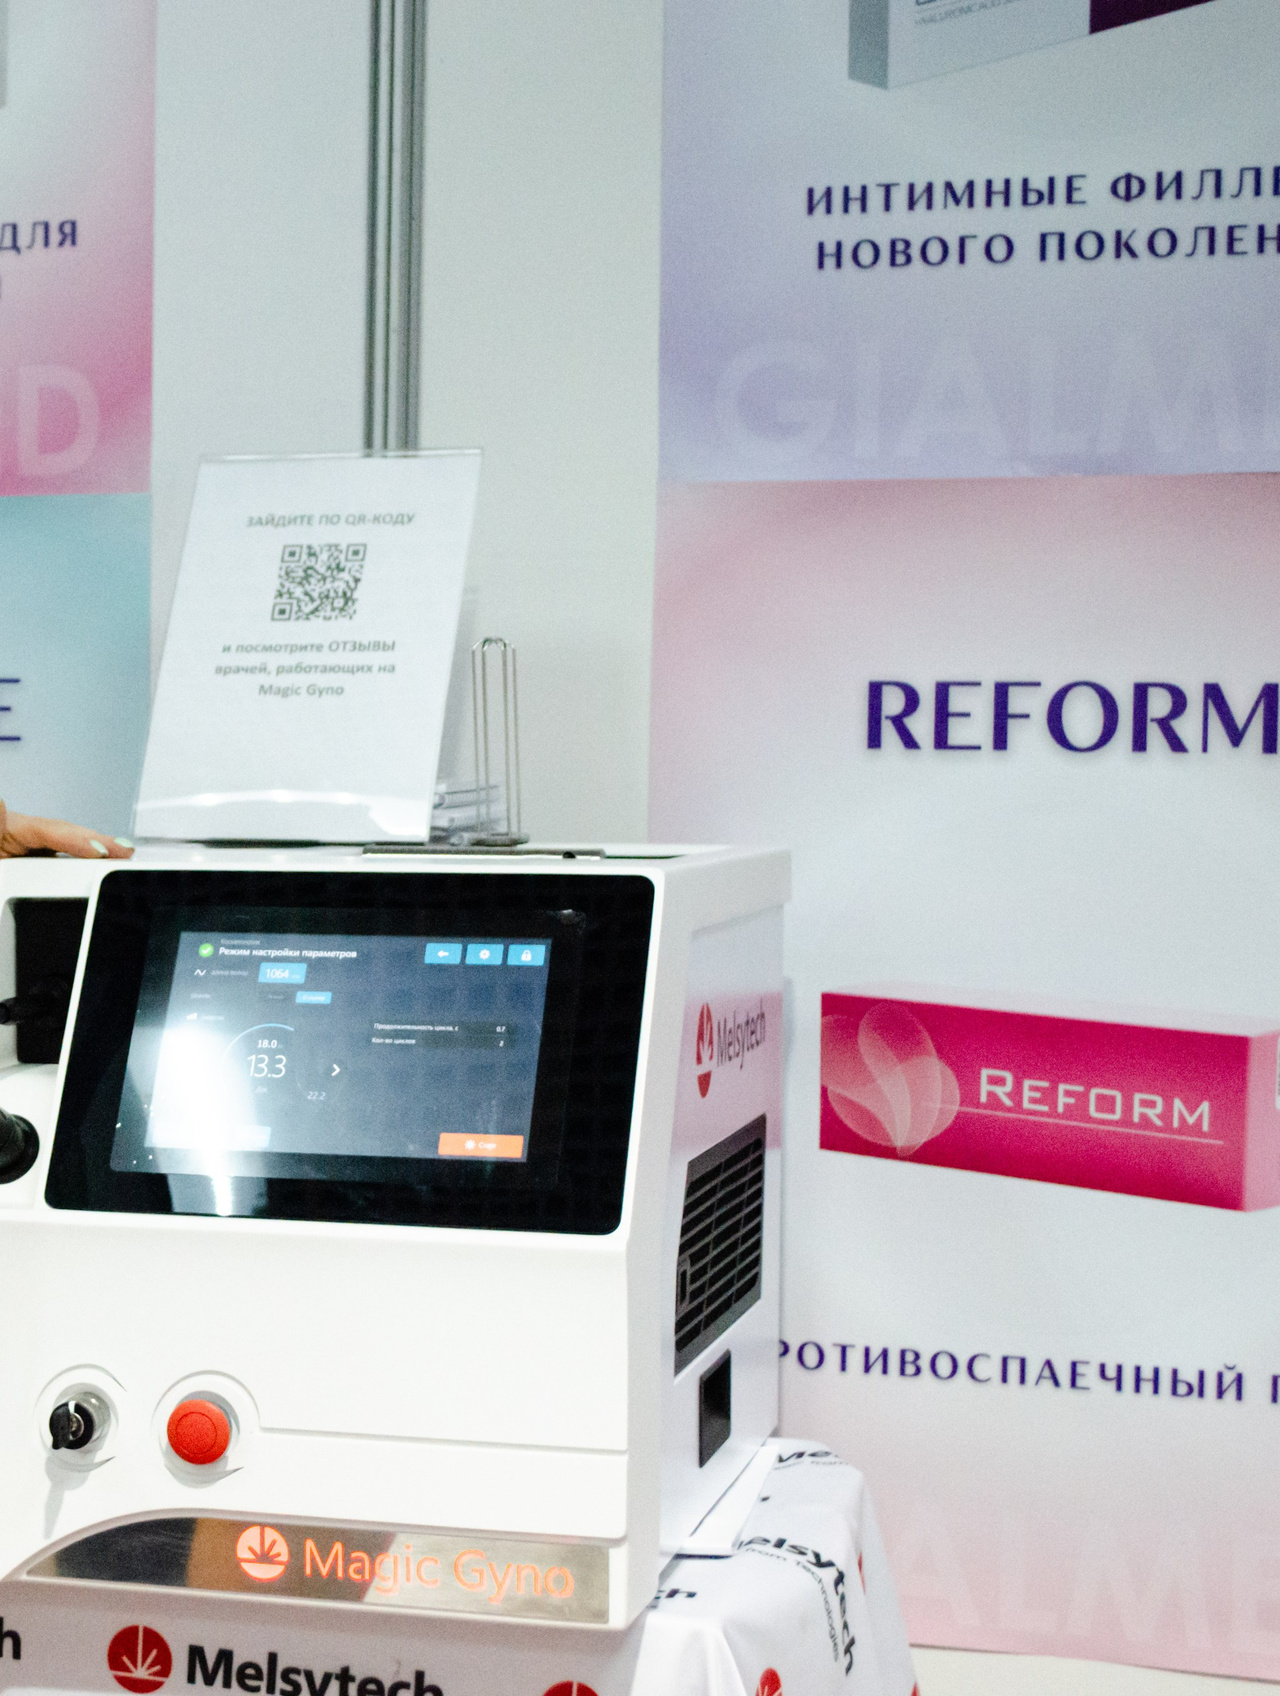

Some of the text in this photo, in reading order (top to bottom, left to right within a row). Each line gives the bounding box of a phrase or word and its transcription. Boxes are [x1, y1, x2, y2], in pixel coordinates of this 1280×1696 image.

[806, 174, 1088, 217] ИНТИМНЫЕ
[817, 223, 1280, 271] НОВОГО ПОКОЛЕН
[246, 512, 416, 529] ЗАЙДИТЕ ПО QR-КОДУ
[222, 639, 396, 656] и посмотрите ОТЗЫВЫ
[215, 661, 396, 676] врачей, работающих на
[258, 683, 344, 698] Magic Gyno
[866, 680, 1280, 755] REFORM
[219, 946, 357, 960] Режим настройки параметров
[265, 968, 289, 979] 1064
[257, 1039, 278, 1049] 18.0
[247, 1054, 287, 1078] 13.3
[303, 1538, 575, 1604] Magic Gyno
